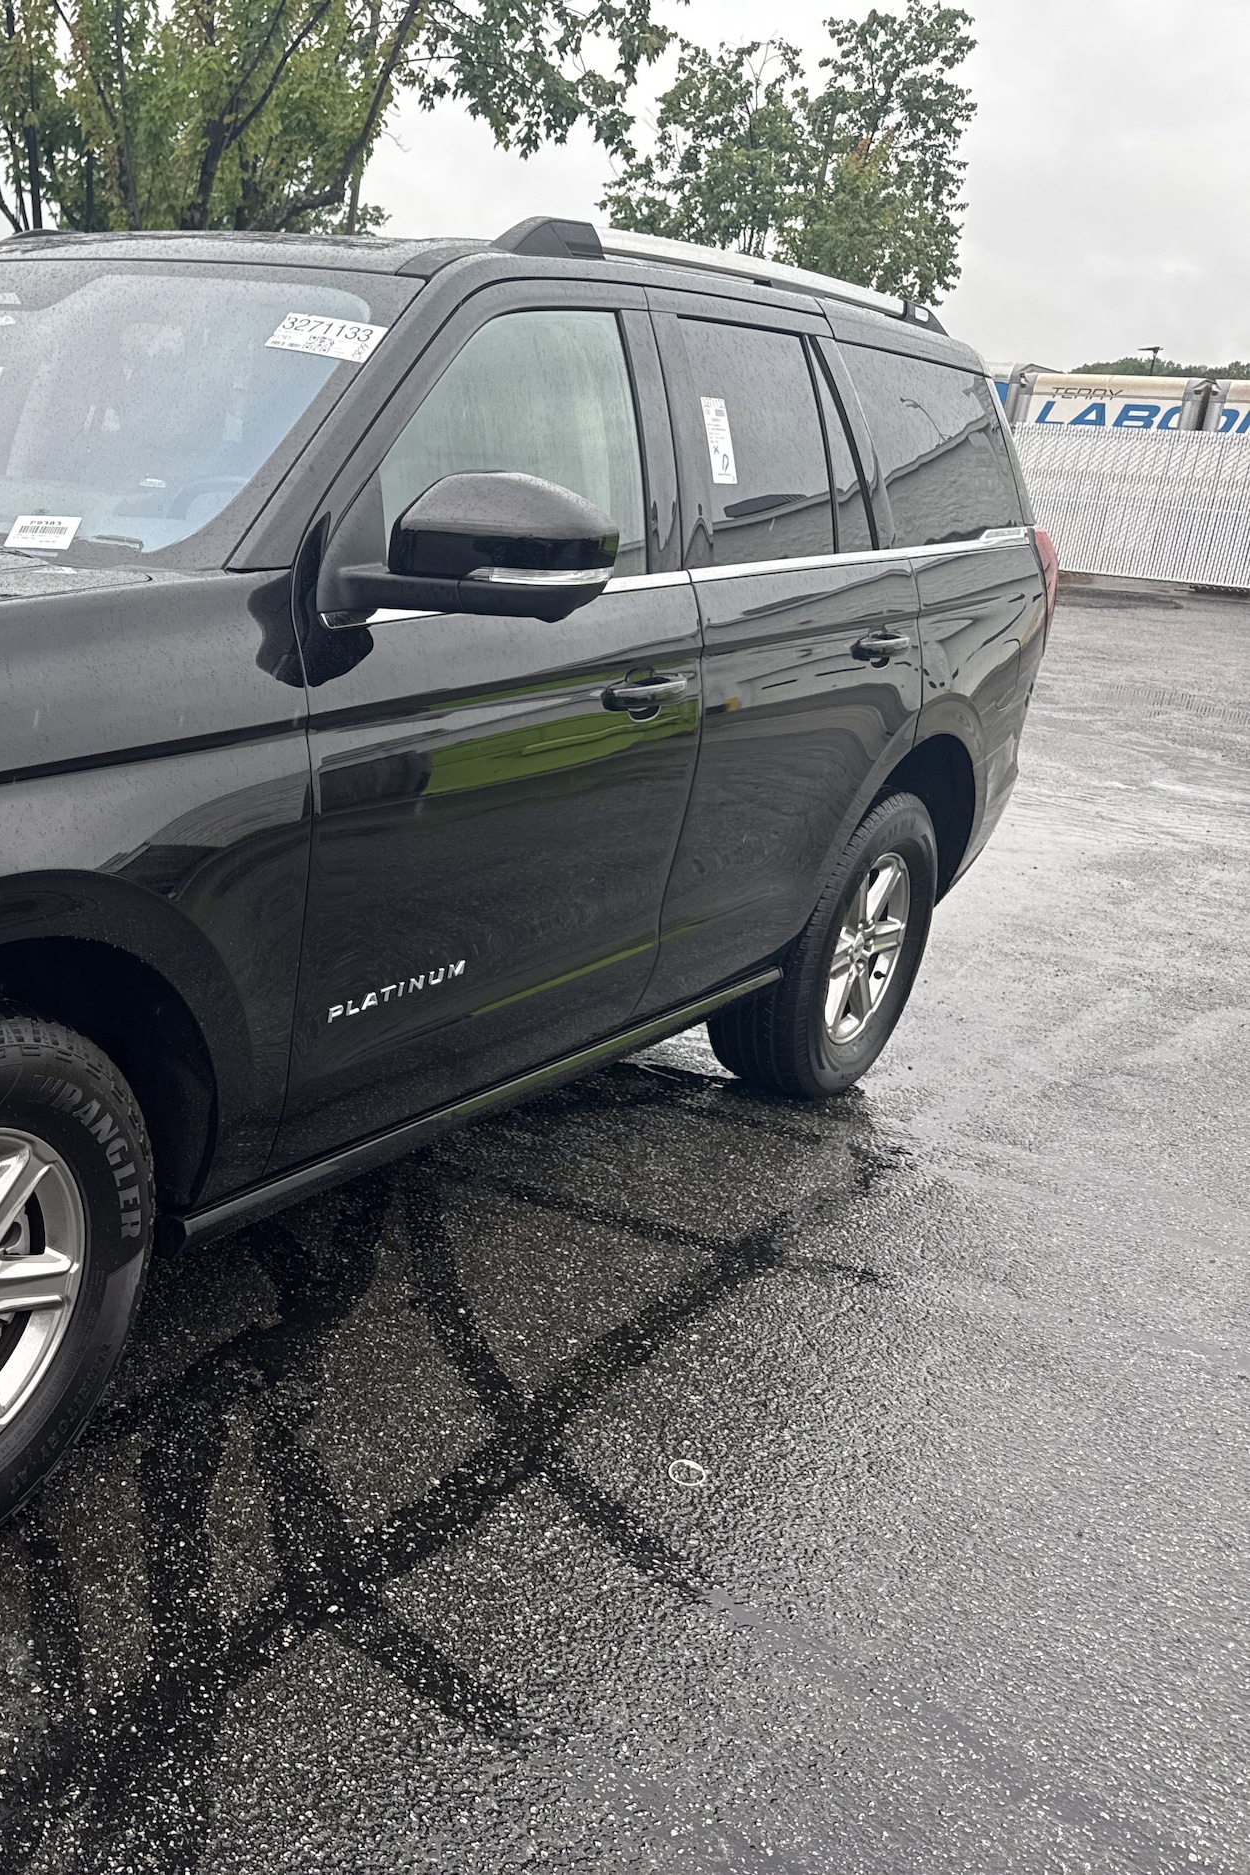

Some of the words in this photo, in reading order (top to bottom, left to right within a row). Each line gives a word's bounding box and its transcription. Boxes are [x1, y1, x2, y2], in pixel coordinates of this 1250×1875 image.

[282, 316, 374, 342] 3271133
[1052, 387, 1124, 401] TERRY
[327, 959, 466, 1024] PLATINUM
[26, 1074, 142, 1239] WRANGLER
